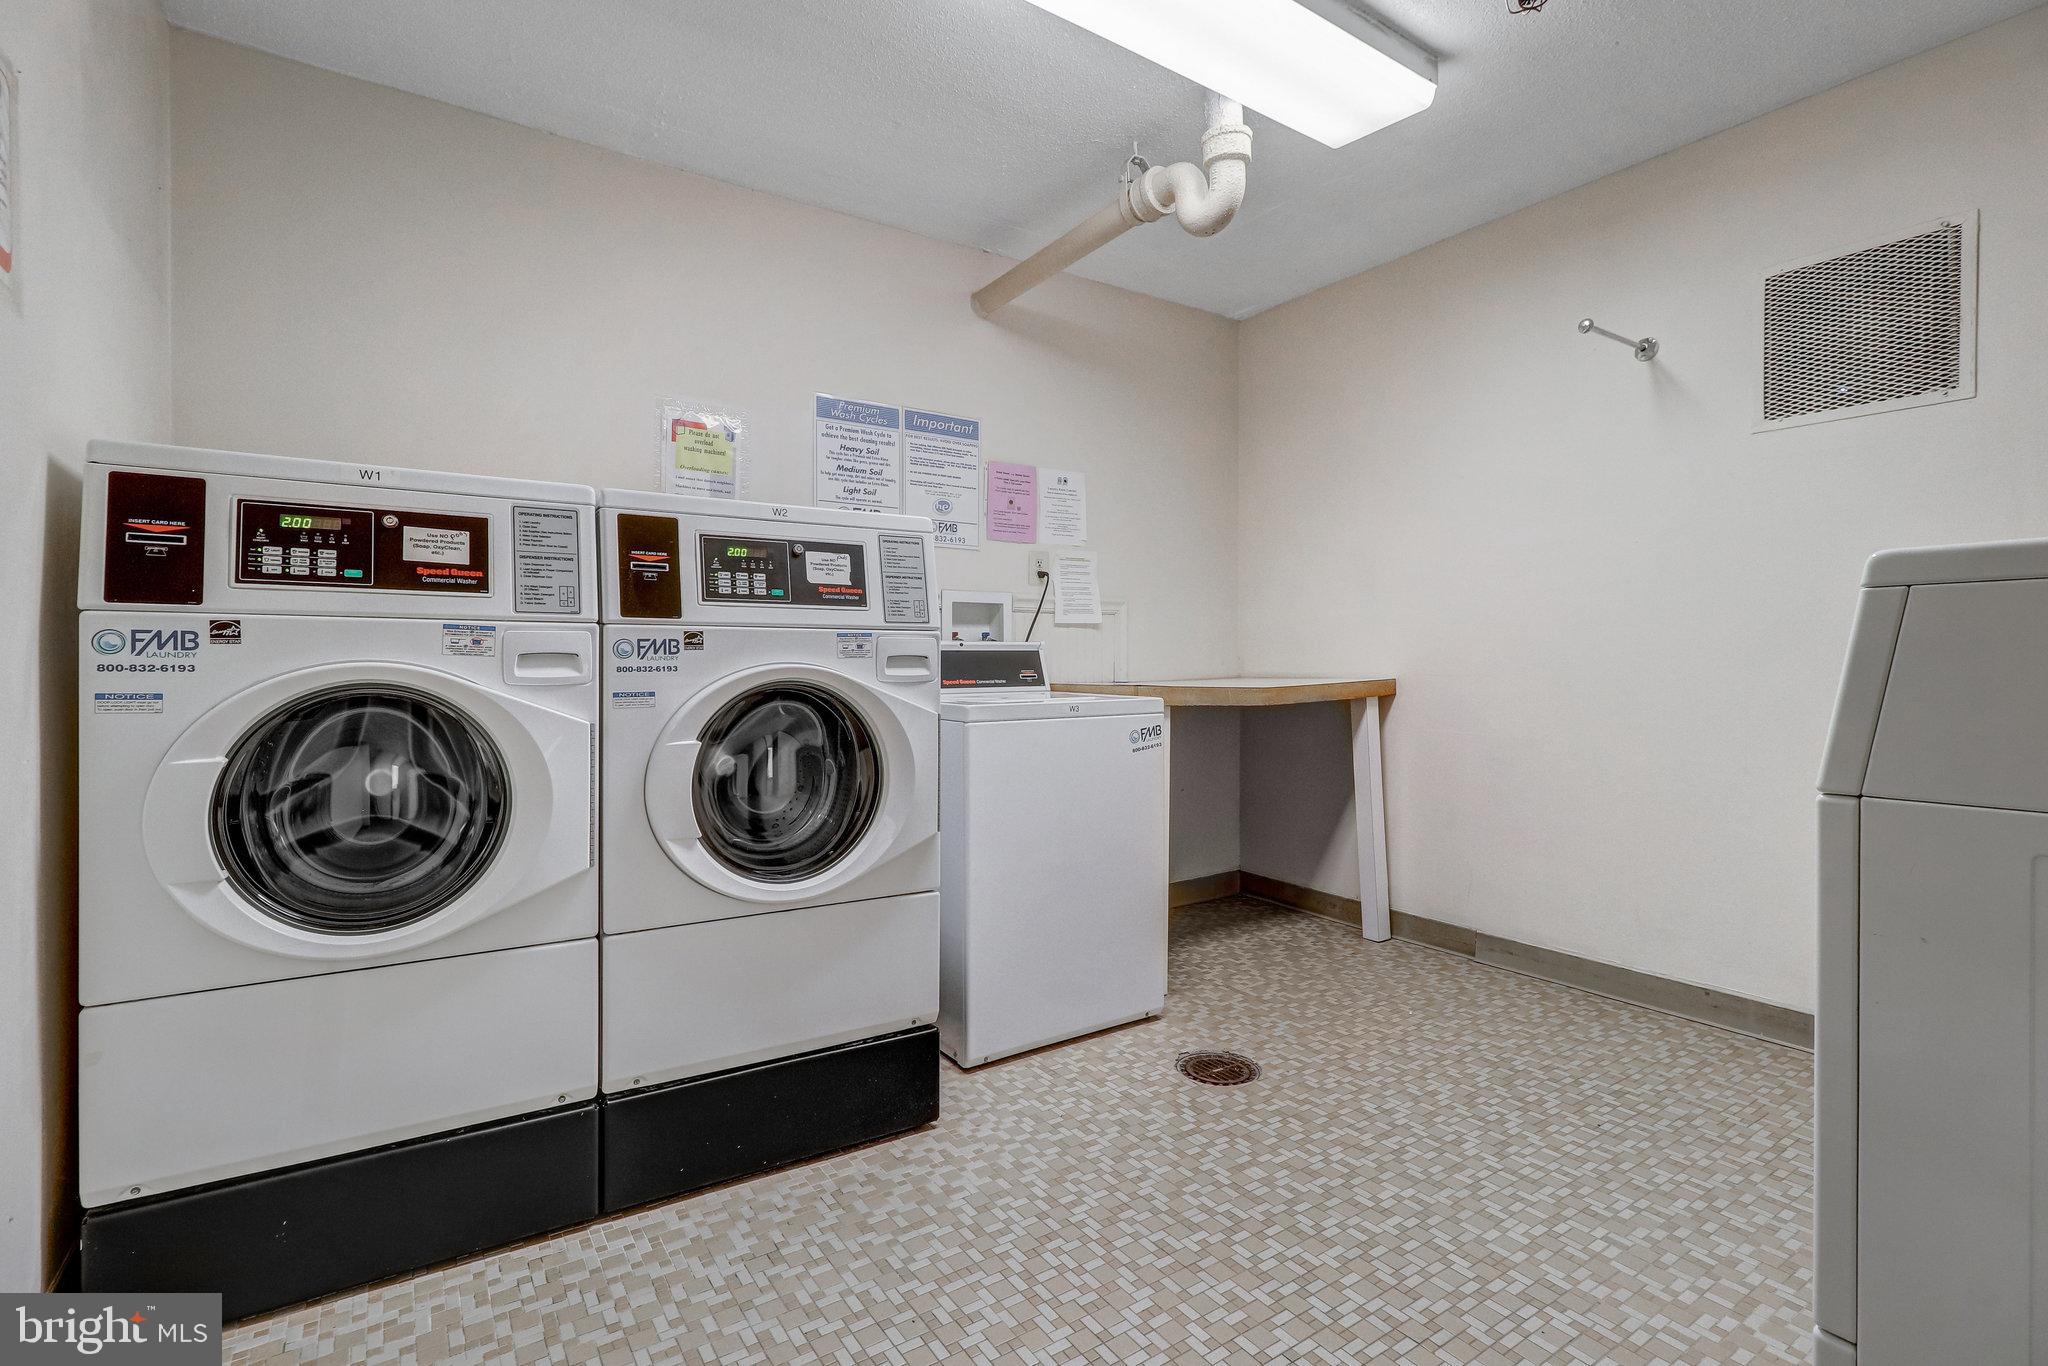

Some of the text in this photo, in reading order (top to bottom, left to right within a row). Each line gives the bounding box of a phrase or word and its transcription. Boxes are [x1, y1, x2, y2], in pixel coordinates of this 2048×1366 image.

[839, 402, 879, 414] Premium
[831, 409, 888, 424] Wash Cycles
[913, 415, 974, 434] Important
[840, 426, 859, 434] Premium
[874, 430, 885, 438] Cycle
[860, 437, 878, 446] cleaning
[684, 446, 702, 454] washing
[840, 444, 863, 454] Heavy
[680, 465, 710, 473] Overloading
[836, 465, 866, 474] Medium
[359, 469, 380, 481] W1
[843, 486, 877, 496] Light Soil
[772, 508, 788, 517] W2
[281, 517, 312, 528] 2.00
[939, 522, 957, 534] FMB
[727, 548, 747, 557] 2.00
[416, 567, 483, 577] Speed Queen
[422, 576, 455, 584] Commercial
[131, 629, 200, 657] FMB
[637, 639, 680, 660] FMB
[96, 664, 195, 672] 800-832-6193
[1140, 725, 1162, 742] FMB
[1132, 742, 1162, 753] 800-832-6193
